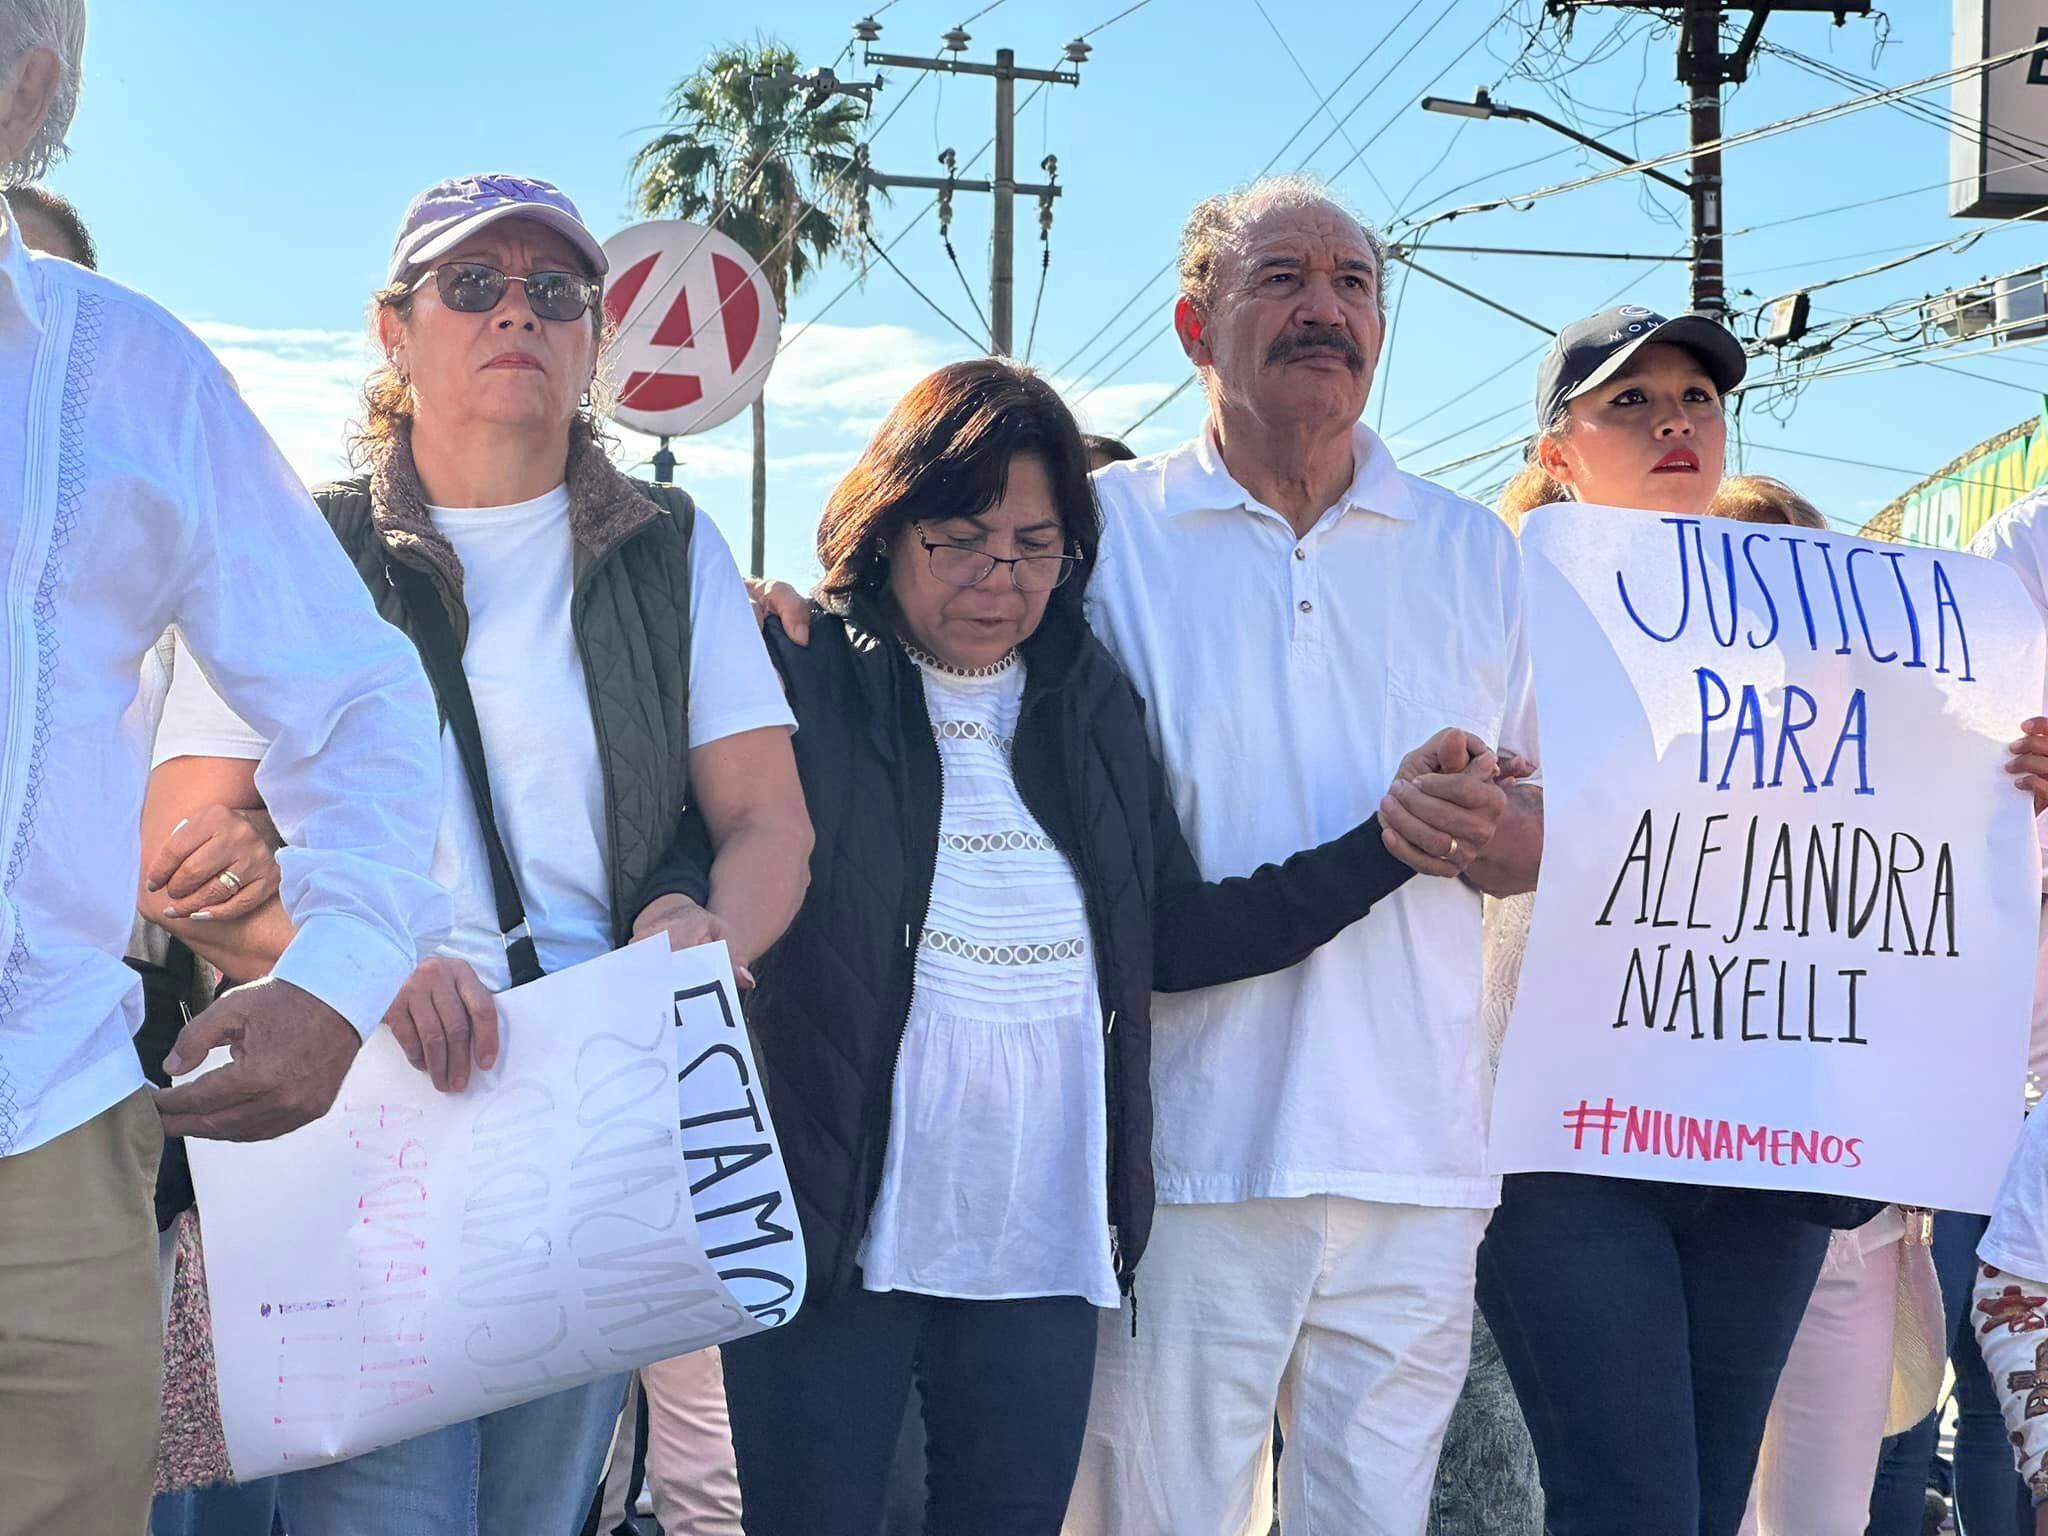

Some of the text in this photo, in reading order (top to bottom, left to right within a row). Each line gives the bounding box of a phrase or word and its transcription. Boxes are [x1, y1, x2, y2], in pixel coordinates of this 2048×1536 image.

[1616, 517, 1976, 682] JUSTICIA
[1693, 666, 1875, 795] PARA
[1595, 809, 1960, 957] ALEJANDRA
[1613, 943, 1867, 1045] NAYELLI
[1563, 1097, 1865, 1169] #NIUNAMENOS
